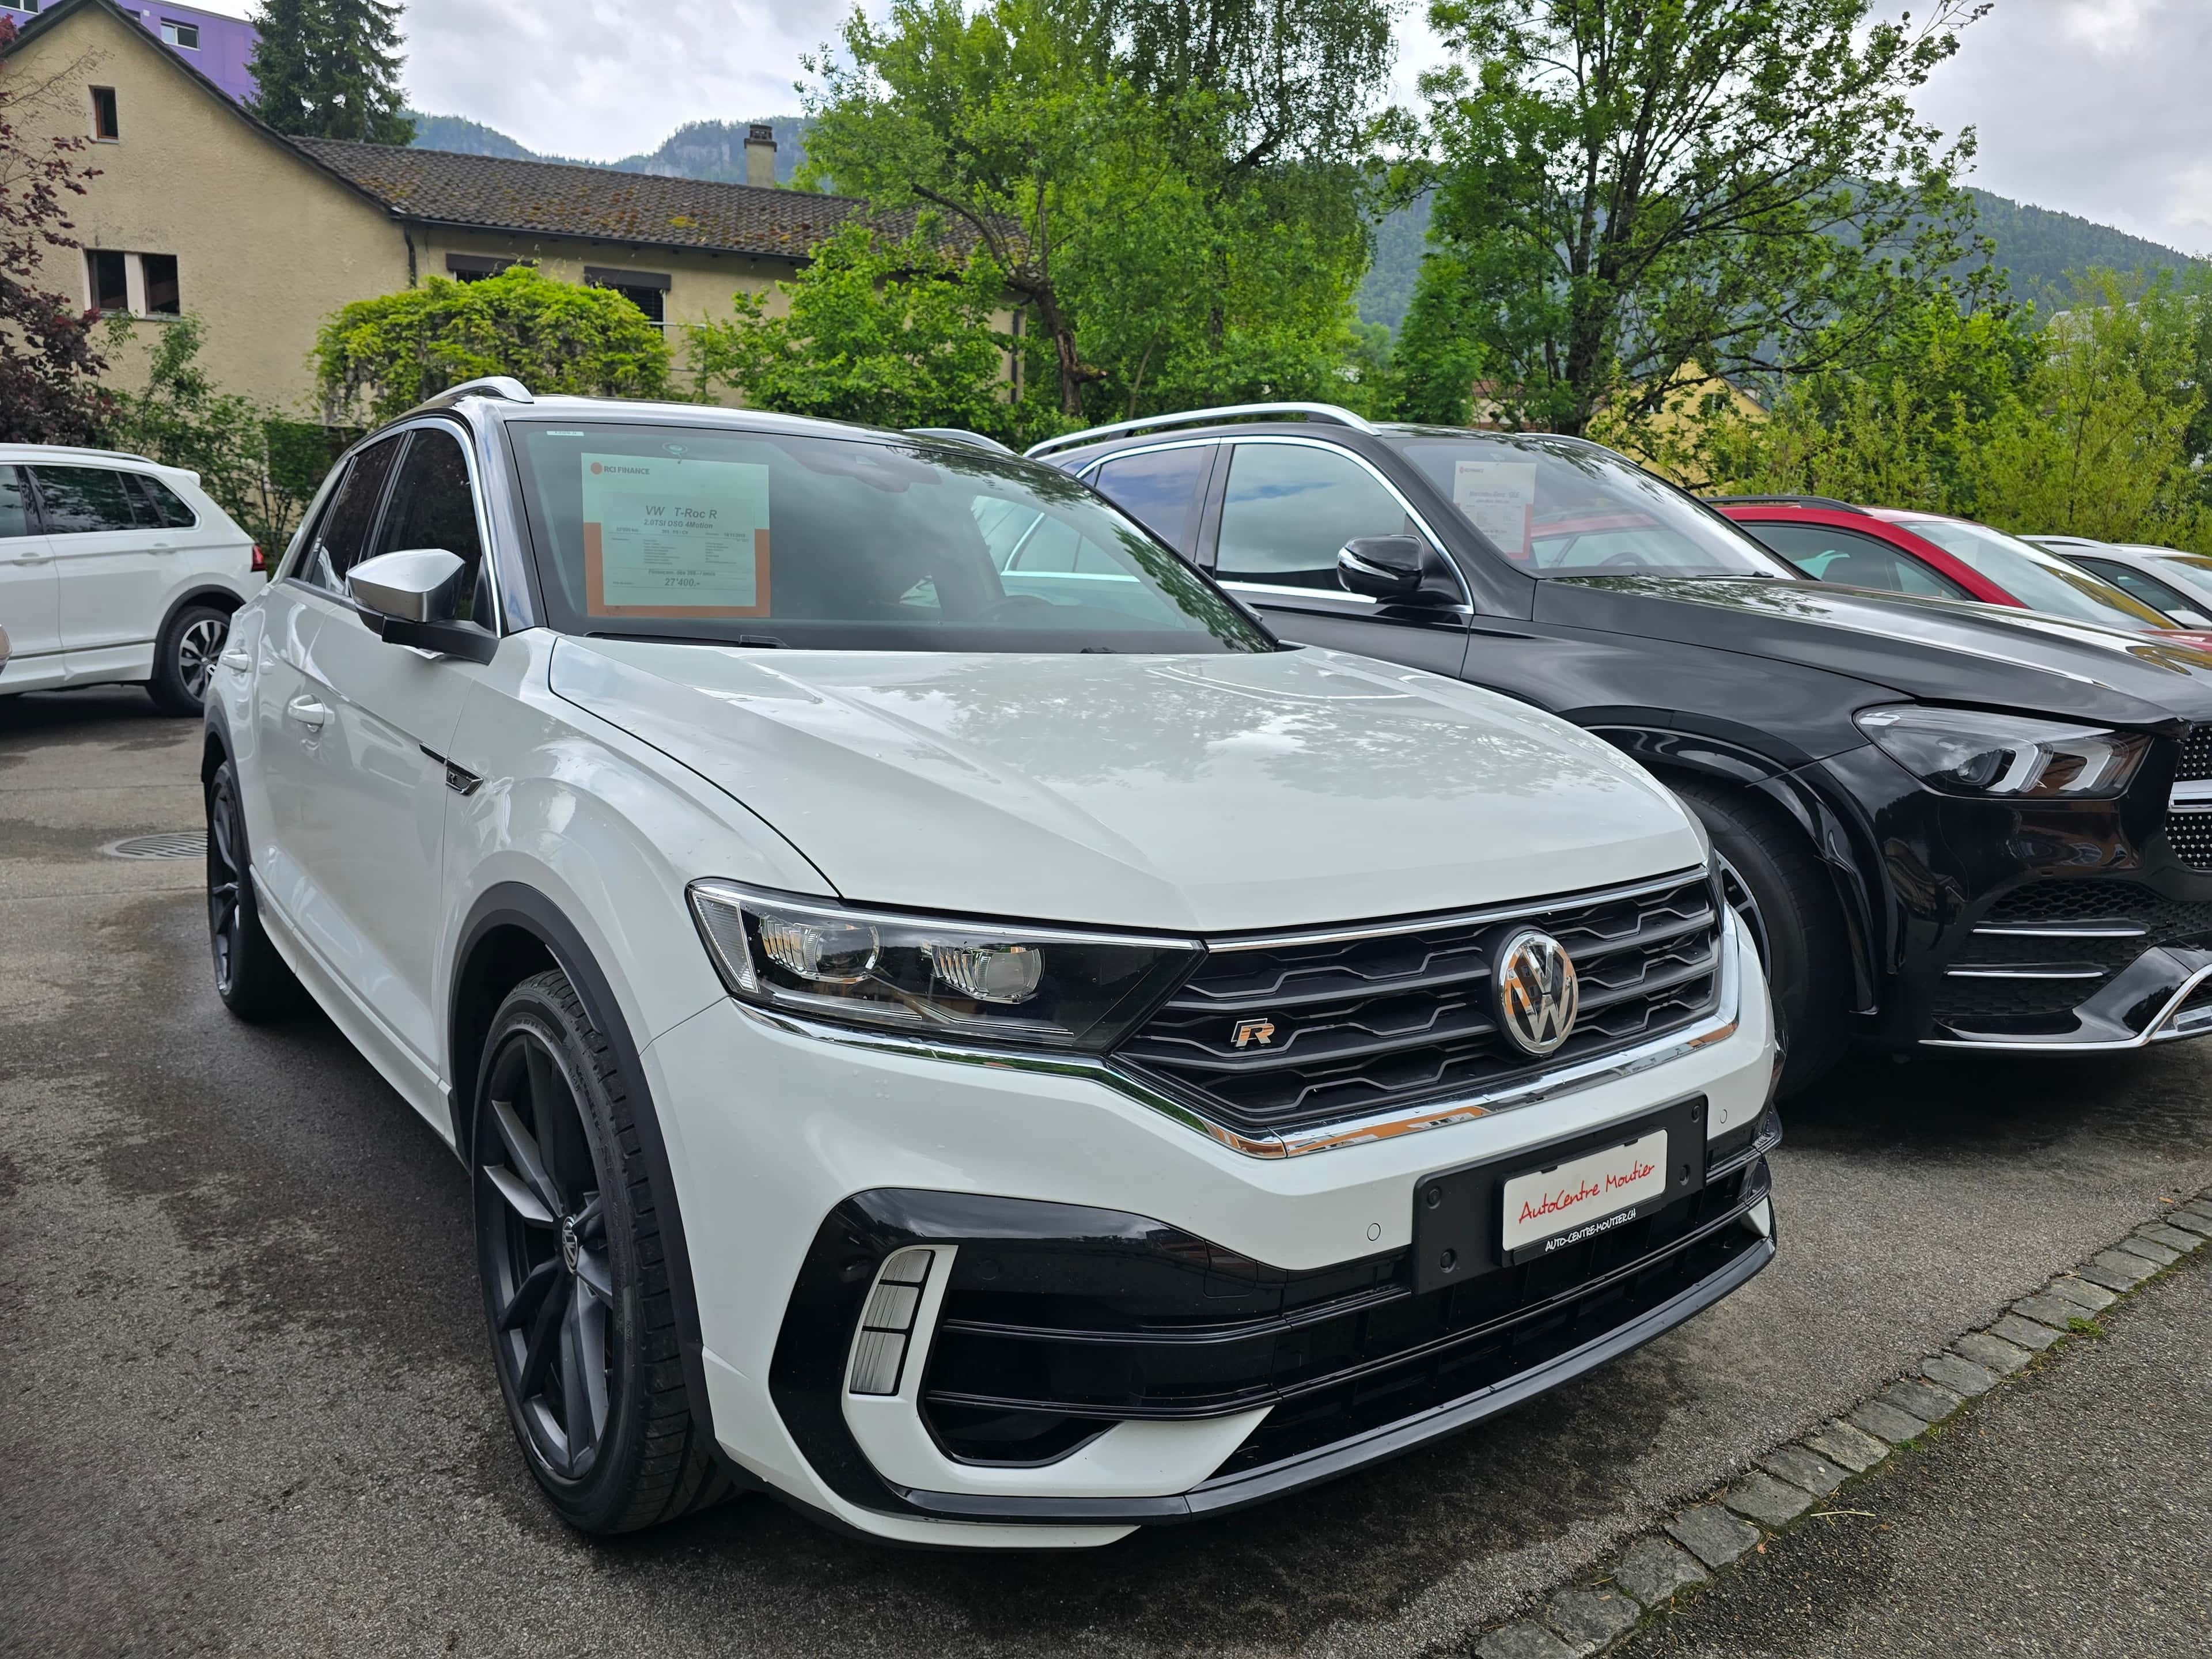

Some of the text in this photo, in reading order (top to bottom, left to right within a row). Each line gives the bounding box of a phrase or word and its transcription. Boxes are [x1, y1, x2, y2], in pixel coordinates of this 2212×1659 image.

[603, 465, 650, 475] RCI FINANCE
[645, 505, 718, 519] VW T-Roc R
[685, 521, 714, 529] 4Motion
[1503, 937, 1575, 1047] VW
[1234, 1022, 1275, 1048] R
[1518, 1160, 1655, 1224] AutoCentre Moutier
